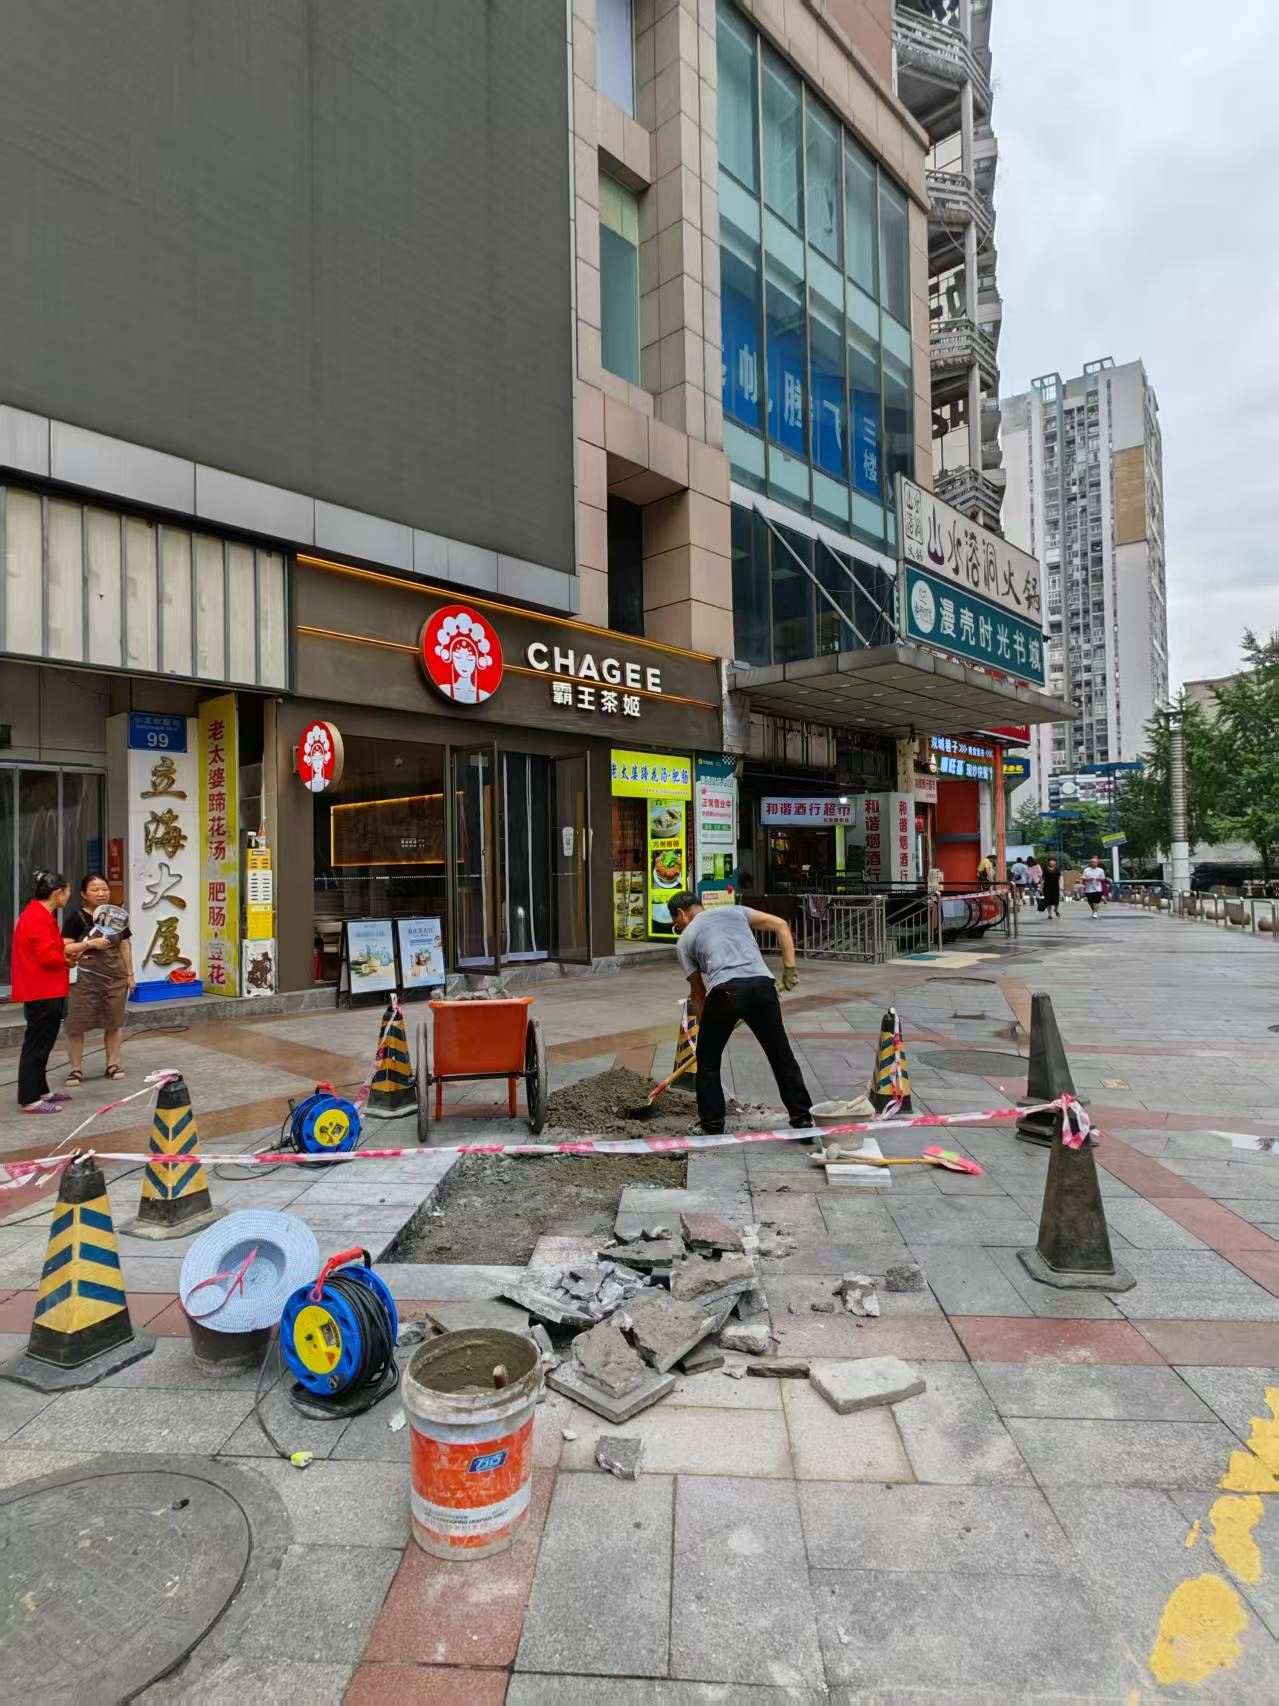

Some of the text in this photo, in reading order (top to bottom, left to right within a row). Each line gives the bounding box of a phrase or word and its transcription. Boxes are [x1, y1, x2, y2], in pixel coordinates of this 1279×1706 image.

[864, 416, 878, 482] 三楼
[527, 642, 662, 693] CHAGEE
[552, 681, 641, 717] 霸王茶姬
[147, 732, 169, 748] 99
[207, 719, 227, 861] 老太婆蹄花汤
[766, 802, 851, 817] 和谐酒行超市
[140, 756, 193, 971] 立海大厦
[864, 799, 881, 882] 和谐烟酒行
